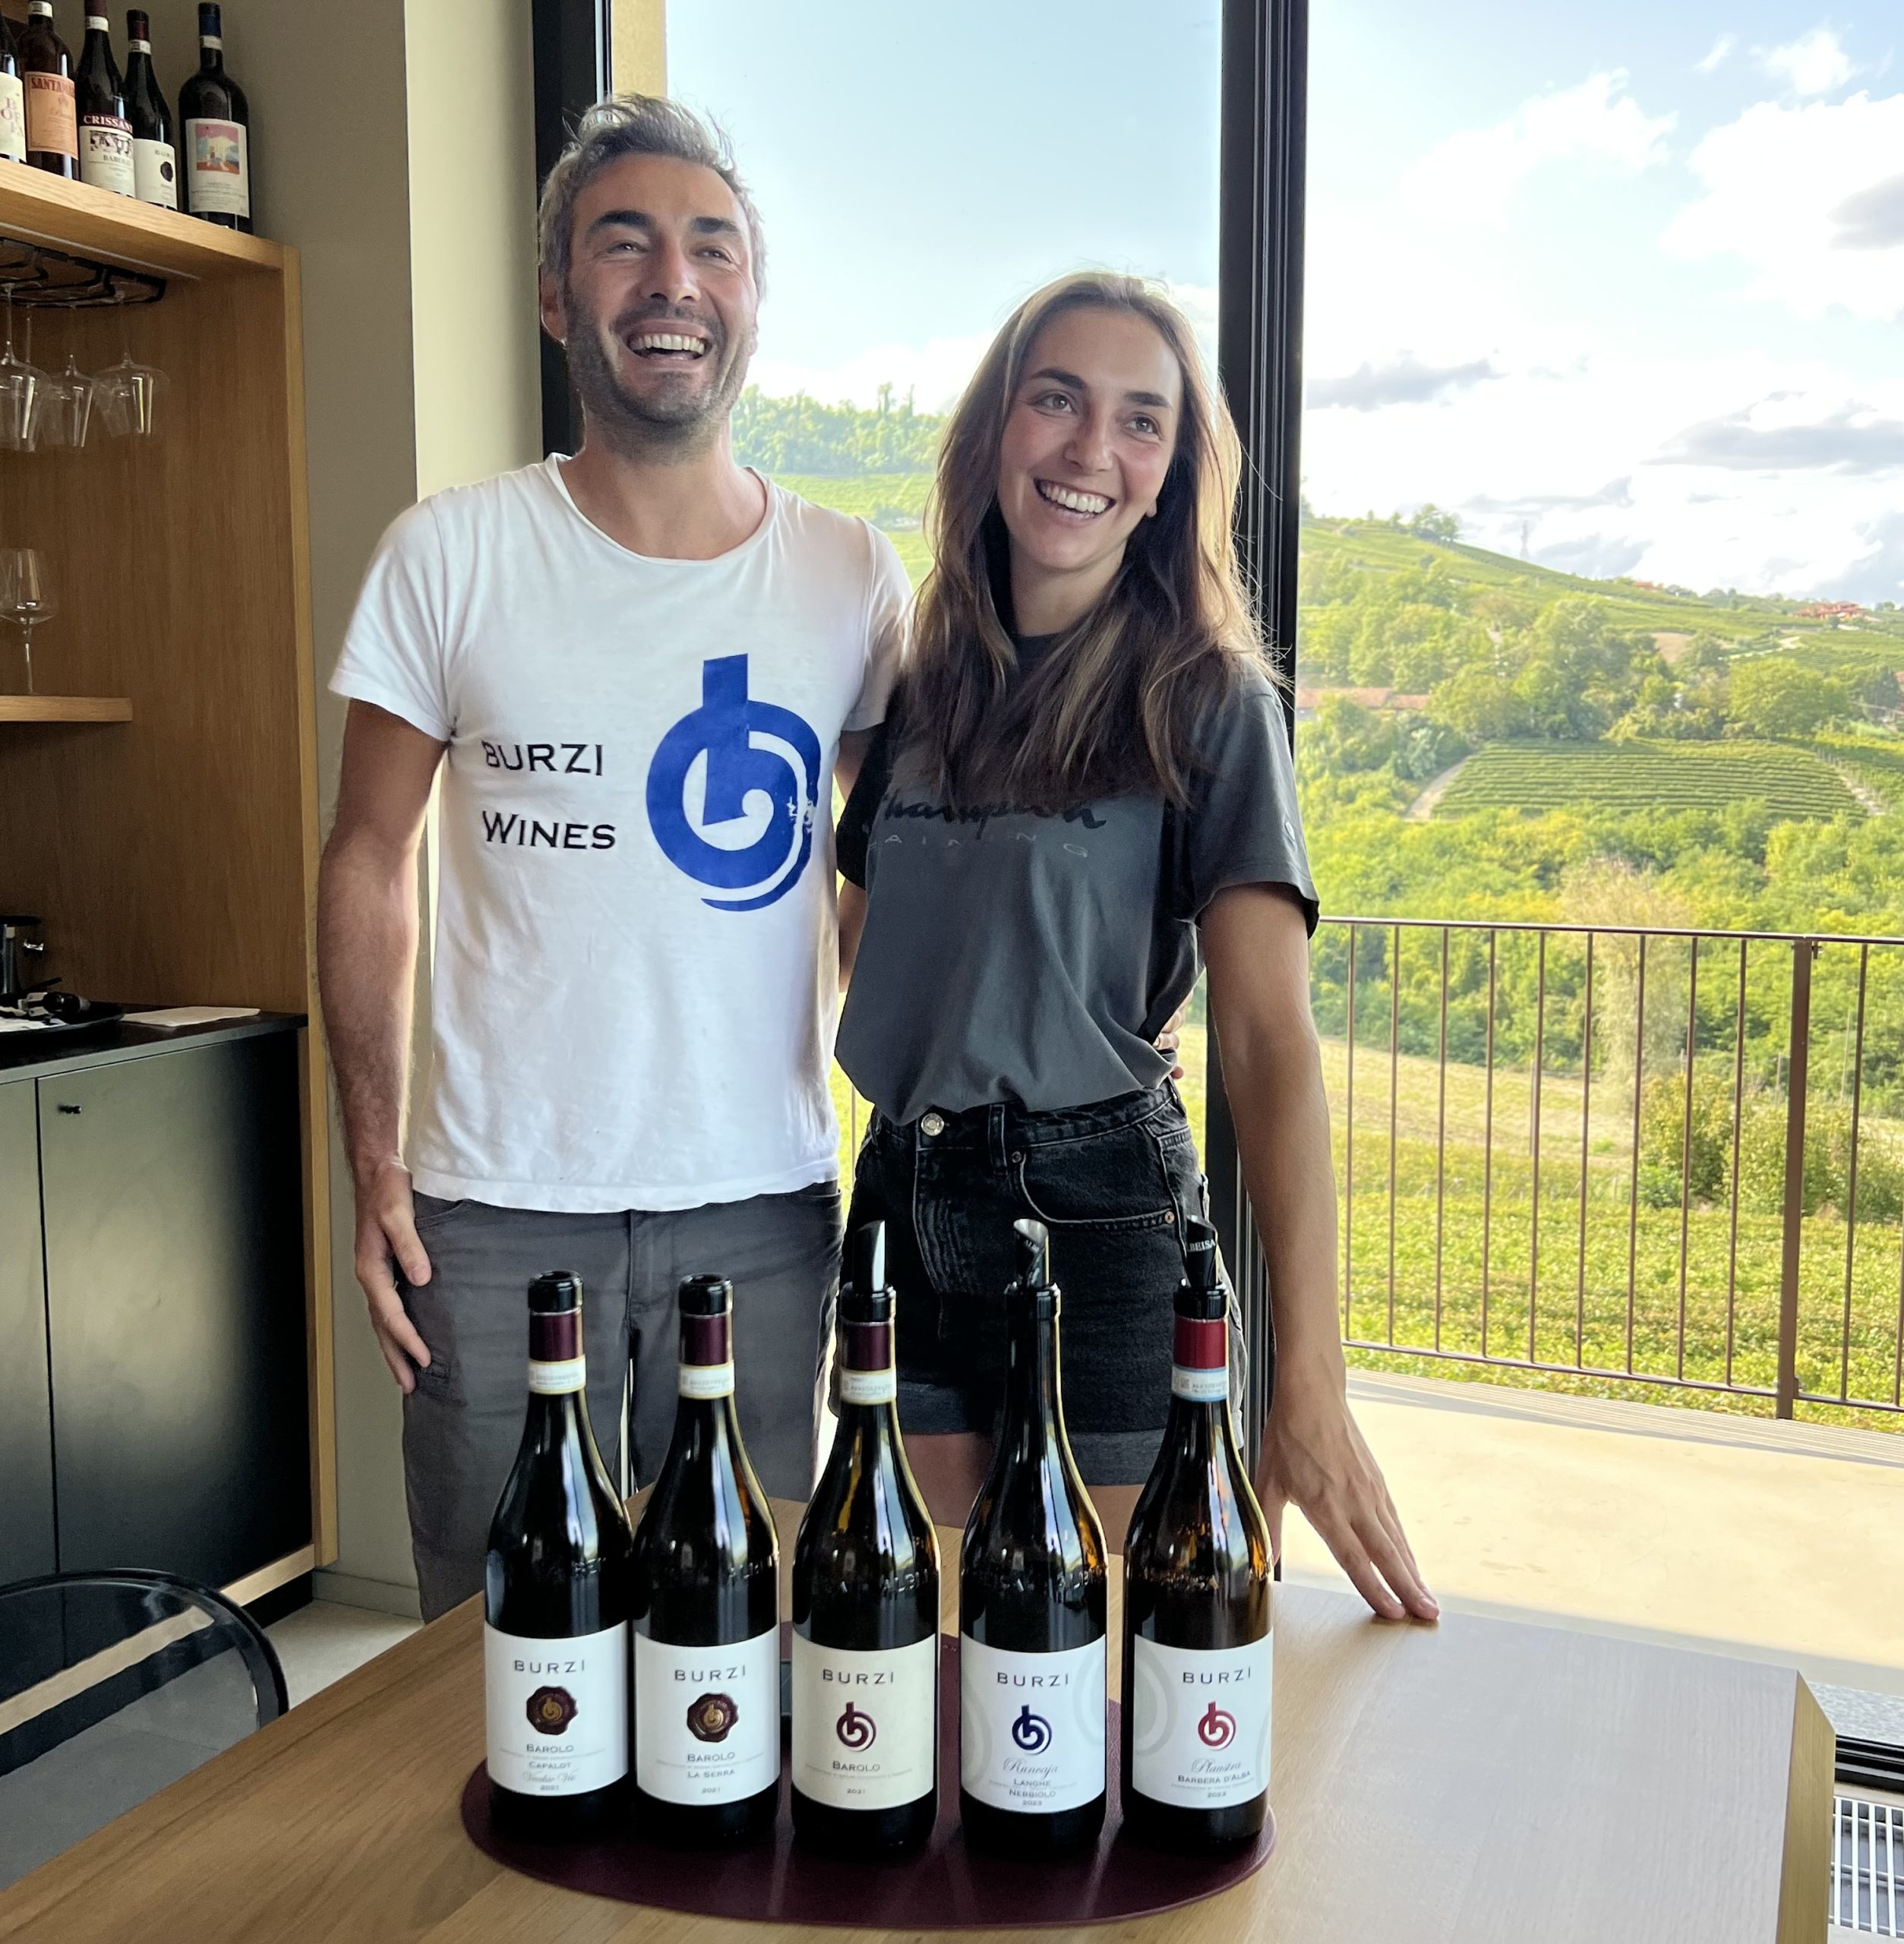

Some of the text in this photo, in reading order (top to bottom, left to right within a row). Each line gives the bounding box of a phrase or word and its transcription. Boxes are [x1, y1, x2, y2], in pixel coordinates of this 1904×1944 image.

[481, 740, 603, 776] BURZI
[482, 810, 616, 850] WINES
[514, 1660, 585, 1674] BURZI
[674, 1667, 746, 1682] BURZI
[823, 1669, 894, 1684] BURZI
[997, 1672, 1069, 1687] BURZI
[1183, 1666, 1251, 1684] BURZI
[526, 1744, 574, 1753] BAROLO
[687, 1752, 736, 1763] BAROLO
[529, 1761, 571, 1769] CAPALOT
[832, 1760, 881, 1772] BAROLO
[687, 1769, 735, 1778] LA SERRA
[1013, 1778, 1052, 1787] LANGHE
[1178, 1775, 1221, 1785] BARBERA
[1009, 1788, 1056, 1799] NEBBIOLO
